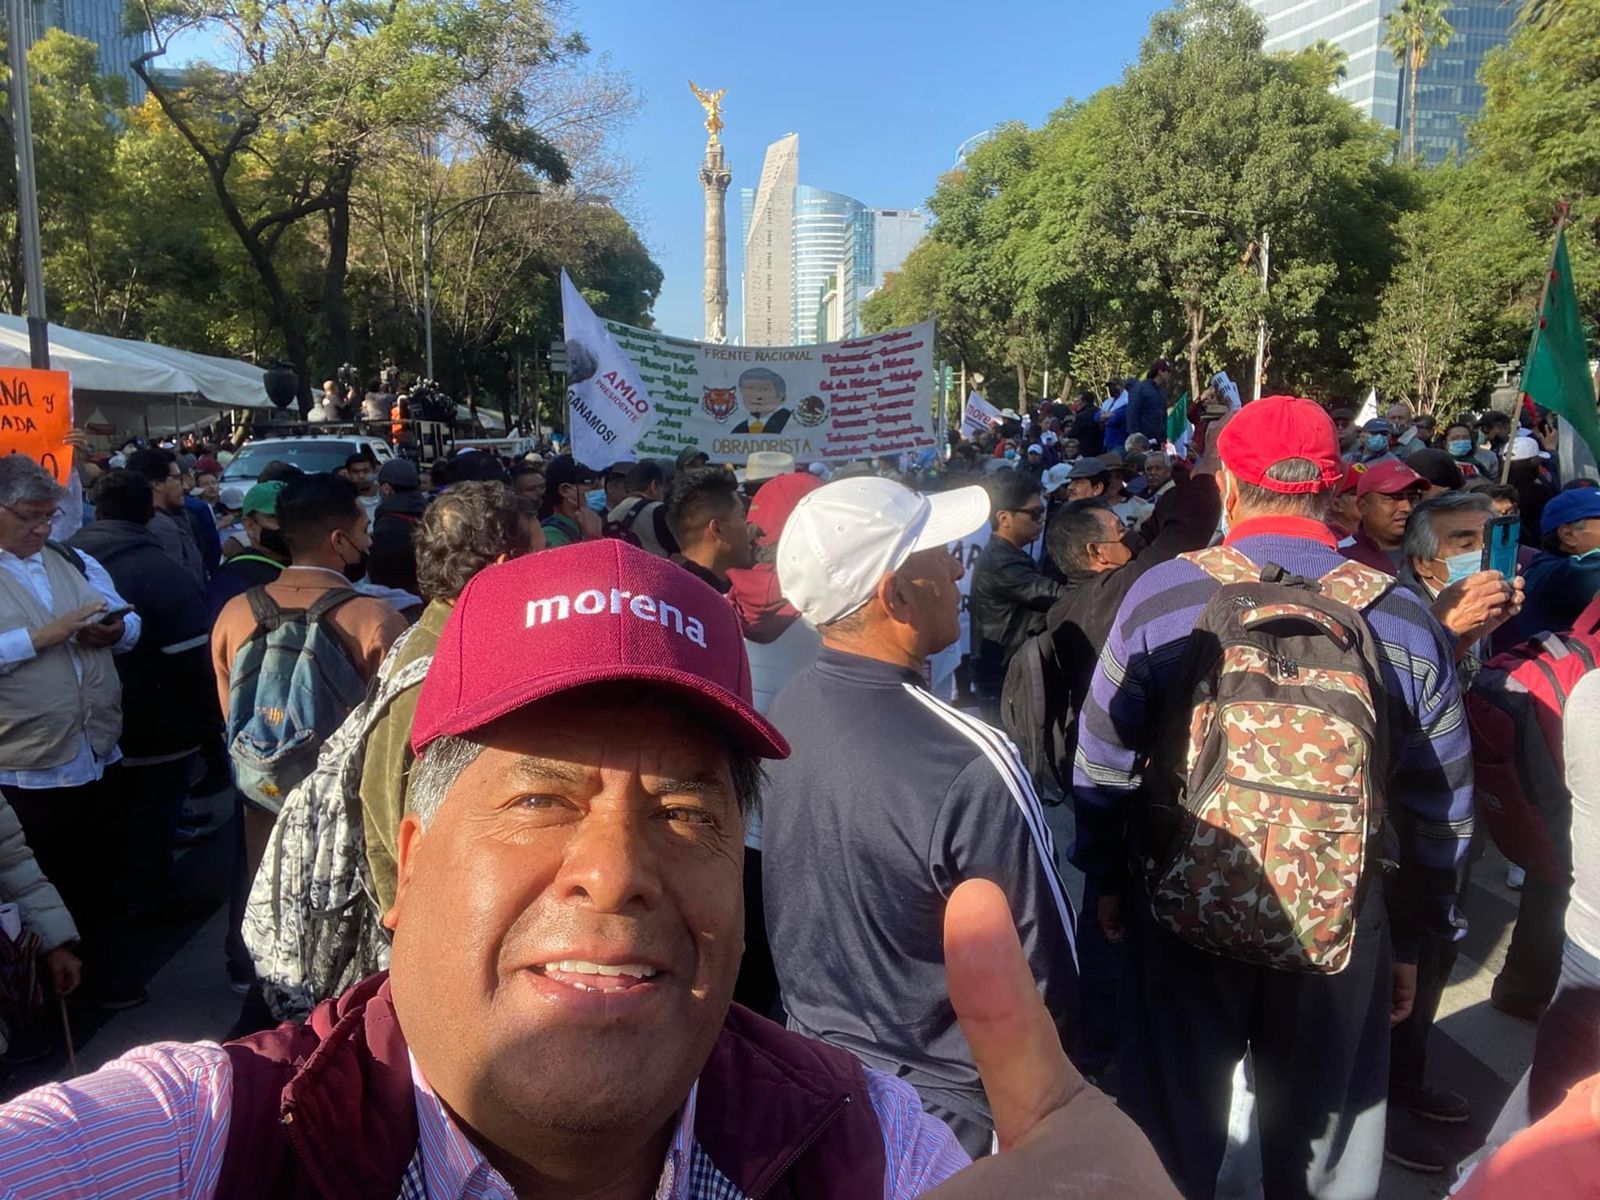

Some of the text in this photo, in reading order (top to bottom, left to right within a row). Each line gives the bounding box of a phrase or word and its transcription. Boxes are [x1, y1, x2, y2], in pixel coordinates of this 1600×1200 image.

[704, 348, 813, 361] FRENTE NACIONAL
[0, 377, 34, 407] NA
[595, 379, 640, 424] PRESIDENTE
[603, 370, 649, 414] AMLO
[712, 438, 812, 454] OBRADORISTA
[525, 587, 707, 649] morena
